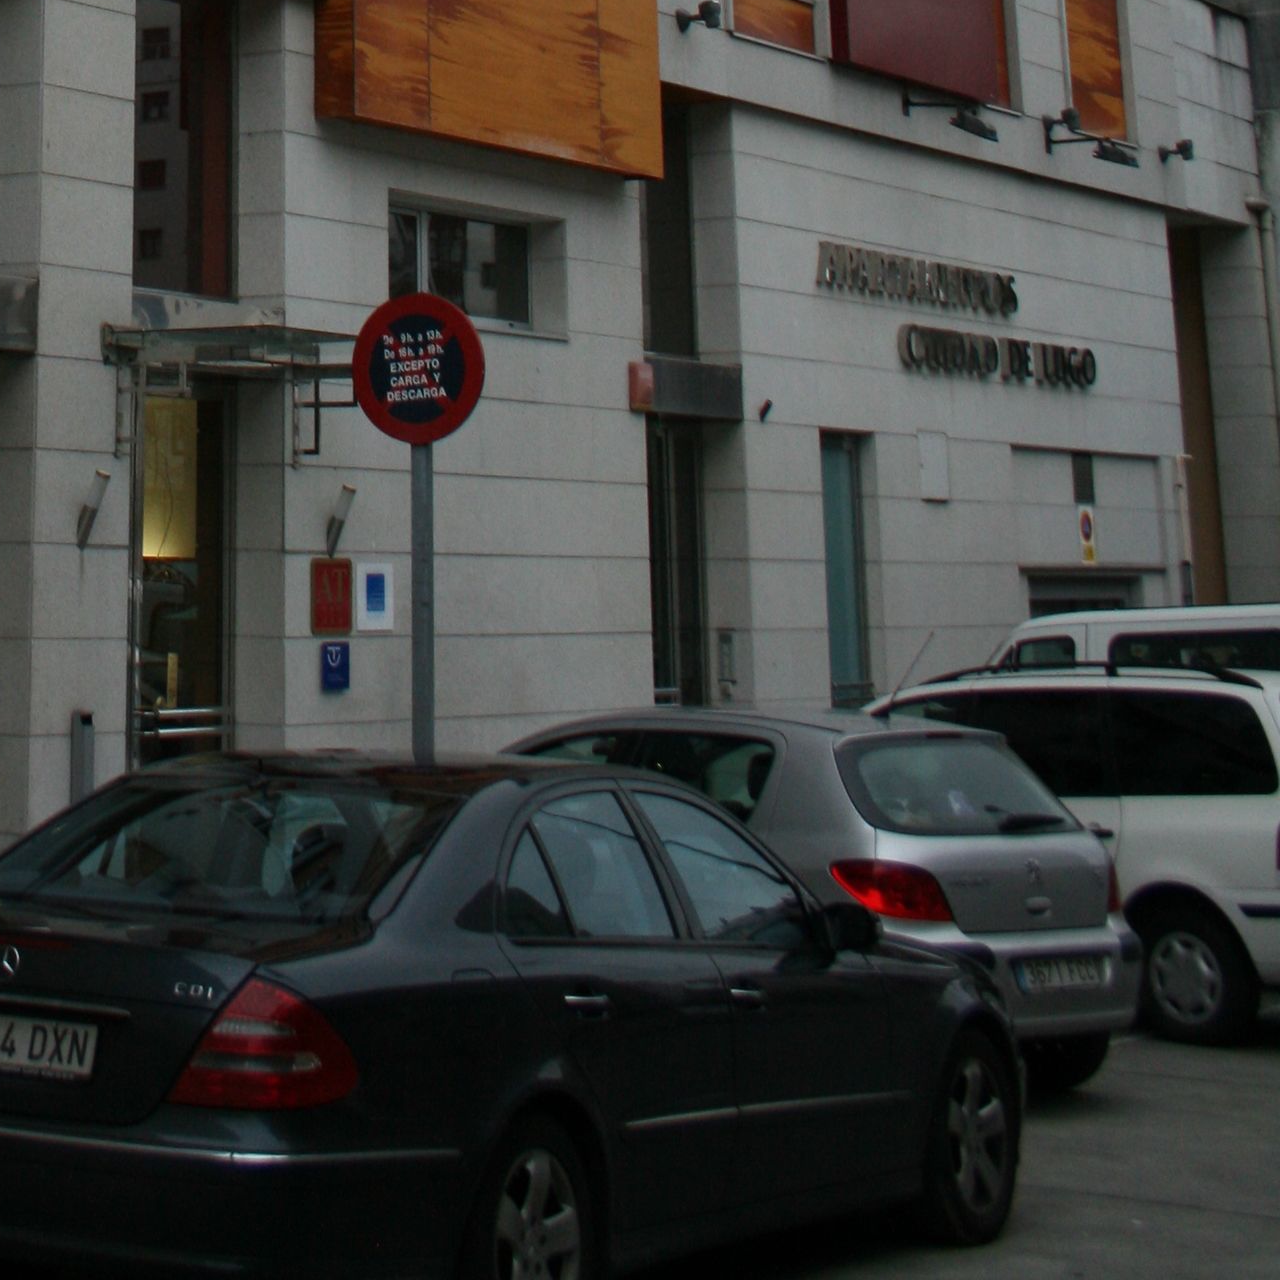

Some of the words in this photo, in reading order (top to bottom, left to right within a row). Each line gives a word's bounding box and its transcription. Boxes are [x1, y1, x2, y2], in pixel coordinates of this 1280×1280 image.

[391, 359, 440, 372] EXCEPTO
[391, 375, 428, 387] CARGA
[433, 372, 441, 384] Y
[387, 387, 447, 401] DESCARGA
[28, 1023, 89, 1067] DXN
